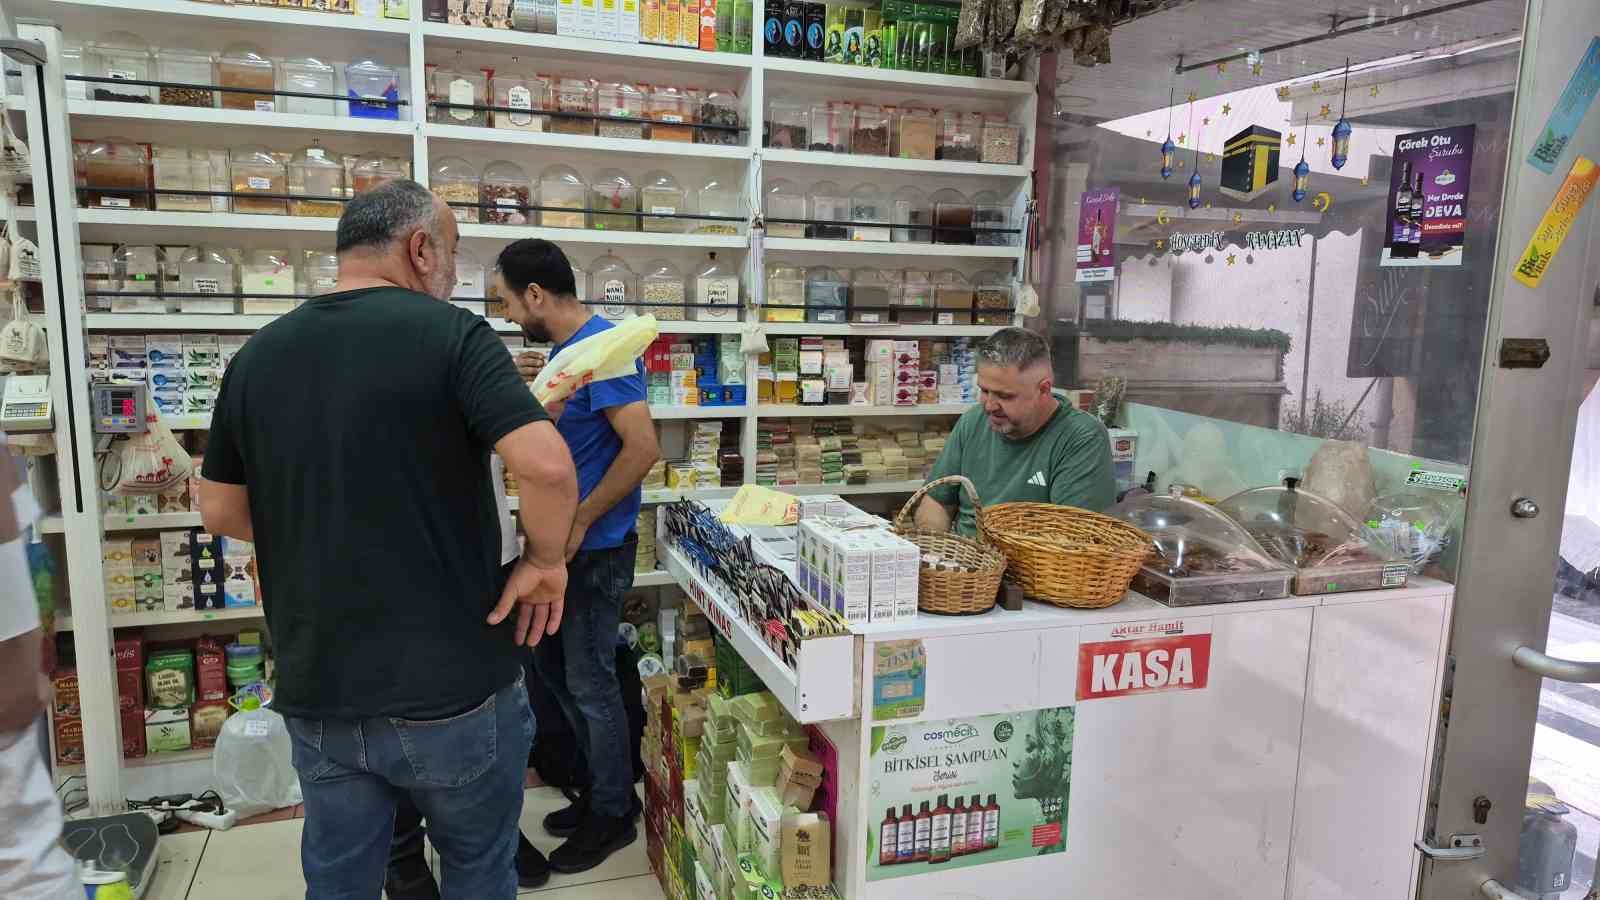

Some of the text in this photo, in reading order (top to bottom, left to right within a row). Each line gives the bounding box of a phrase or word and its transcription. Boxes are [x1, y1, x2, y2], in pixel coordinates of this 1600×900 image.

[1399, 135, 1451, 152] Çörek Otu
[1425, 204, 1462, 218] DEVA
[1112, 623, 1147, 636] Aktar
[1091, 647, 1194, 693] KASA
[884, 747, 1009, 774] BİTKİSEL ŞAMPUAN
